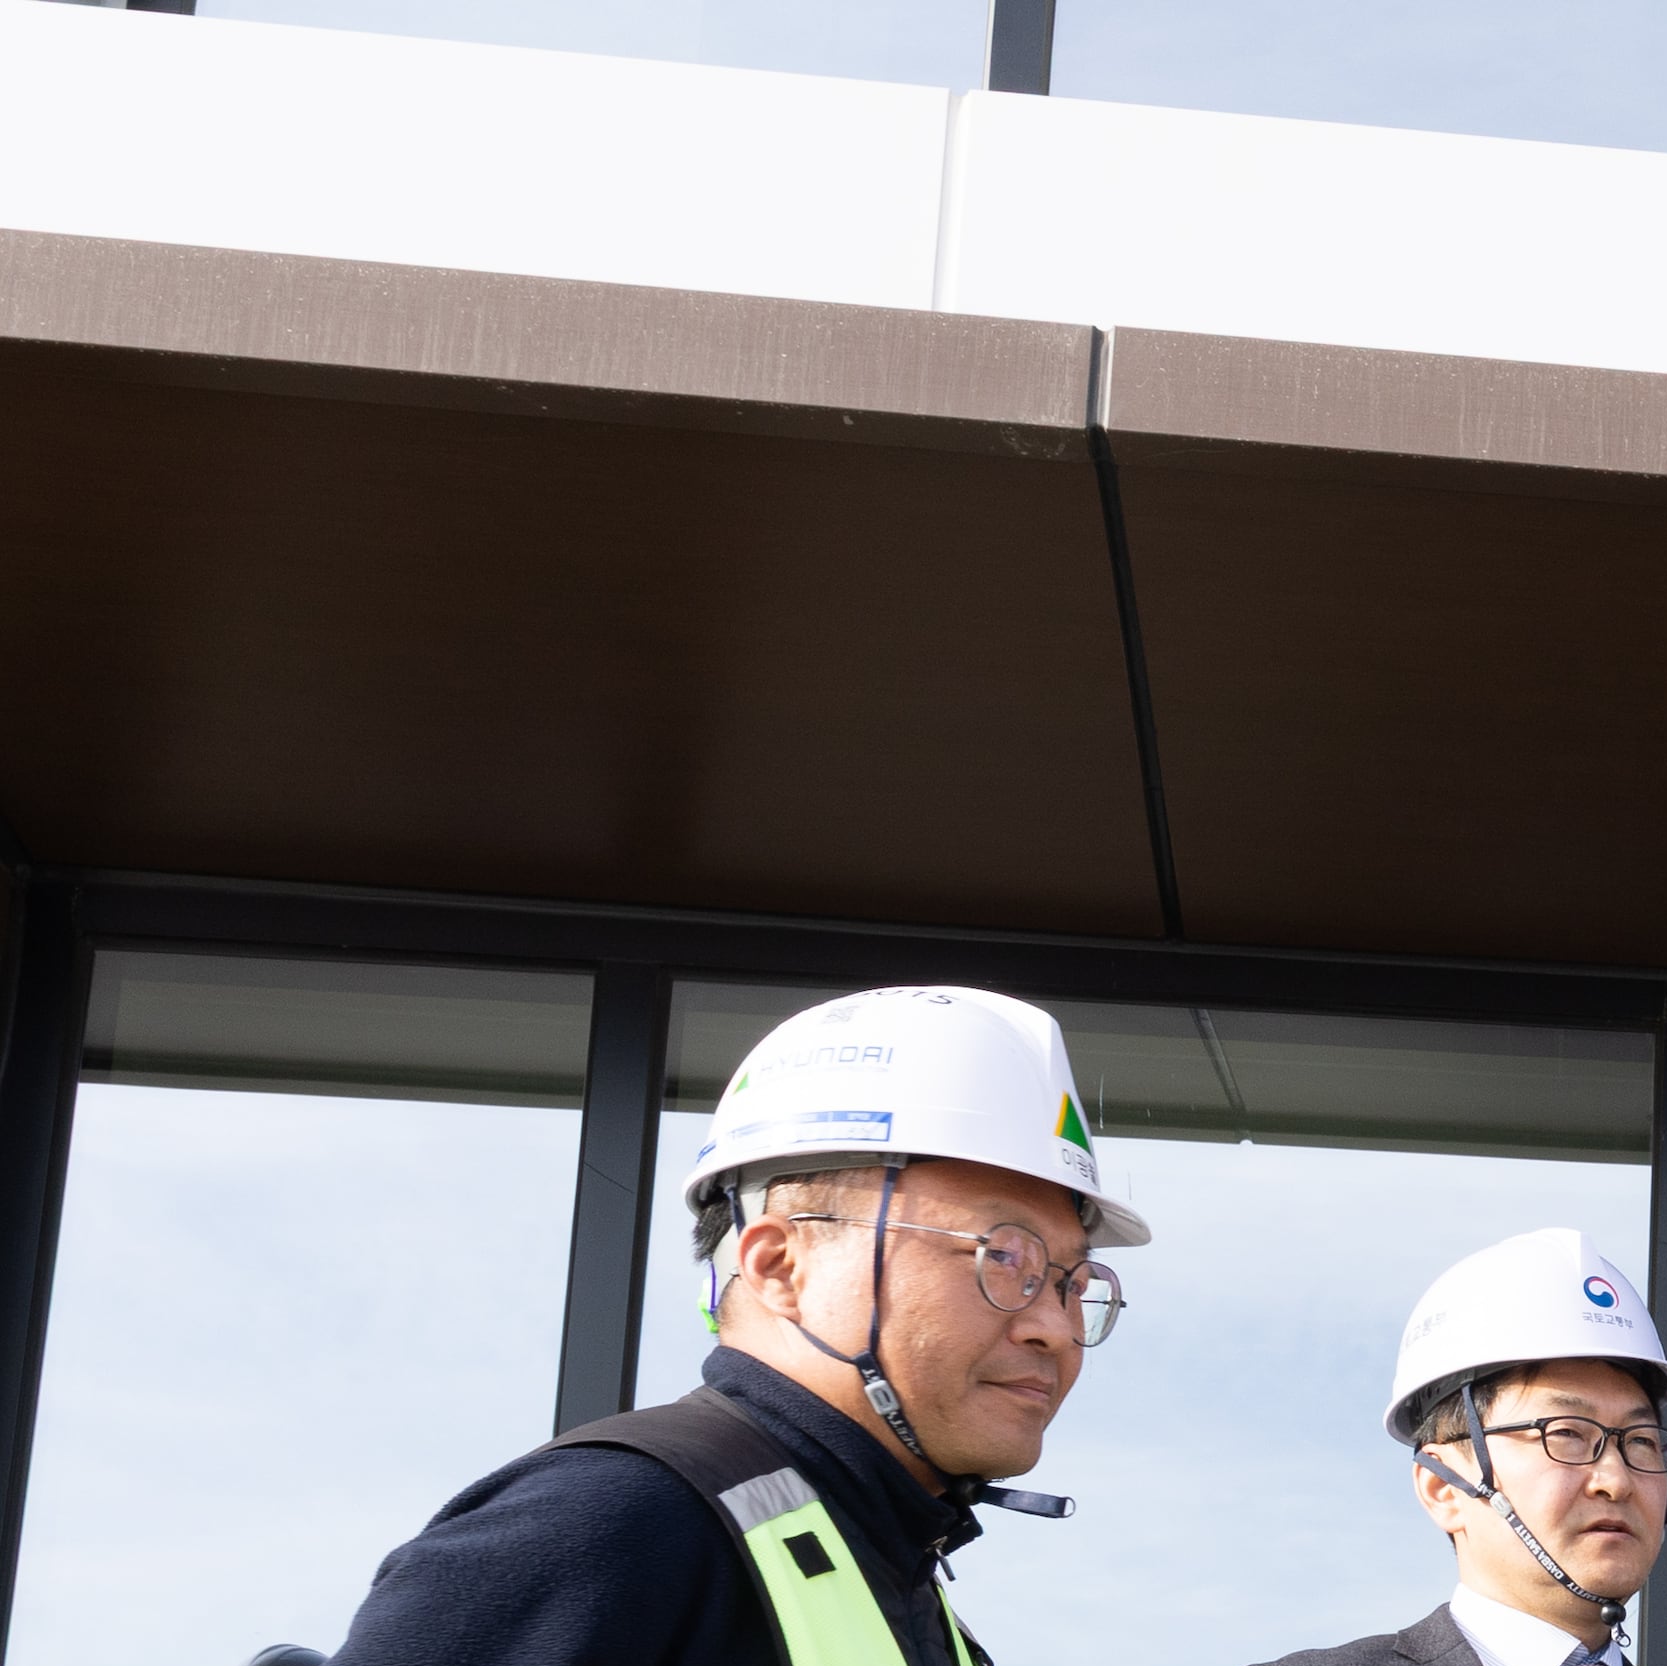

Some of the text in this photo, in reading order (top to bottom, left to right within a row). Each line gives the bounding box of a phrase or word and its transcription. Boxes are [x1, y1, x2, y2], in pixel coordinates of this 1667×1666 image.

[761, 1046, 894, 1075] HYUNDAI
[1581, 1310, 1635, 1330] 국토교통부
[1514, 1523, 1541, 1555] SAFETY
